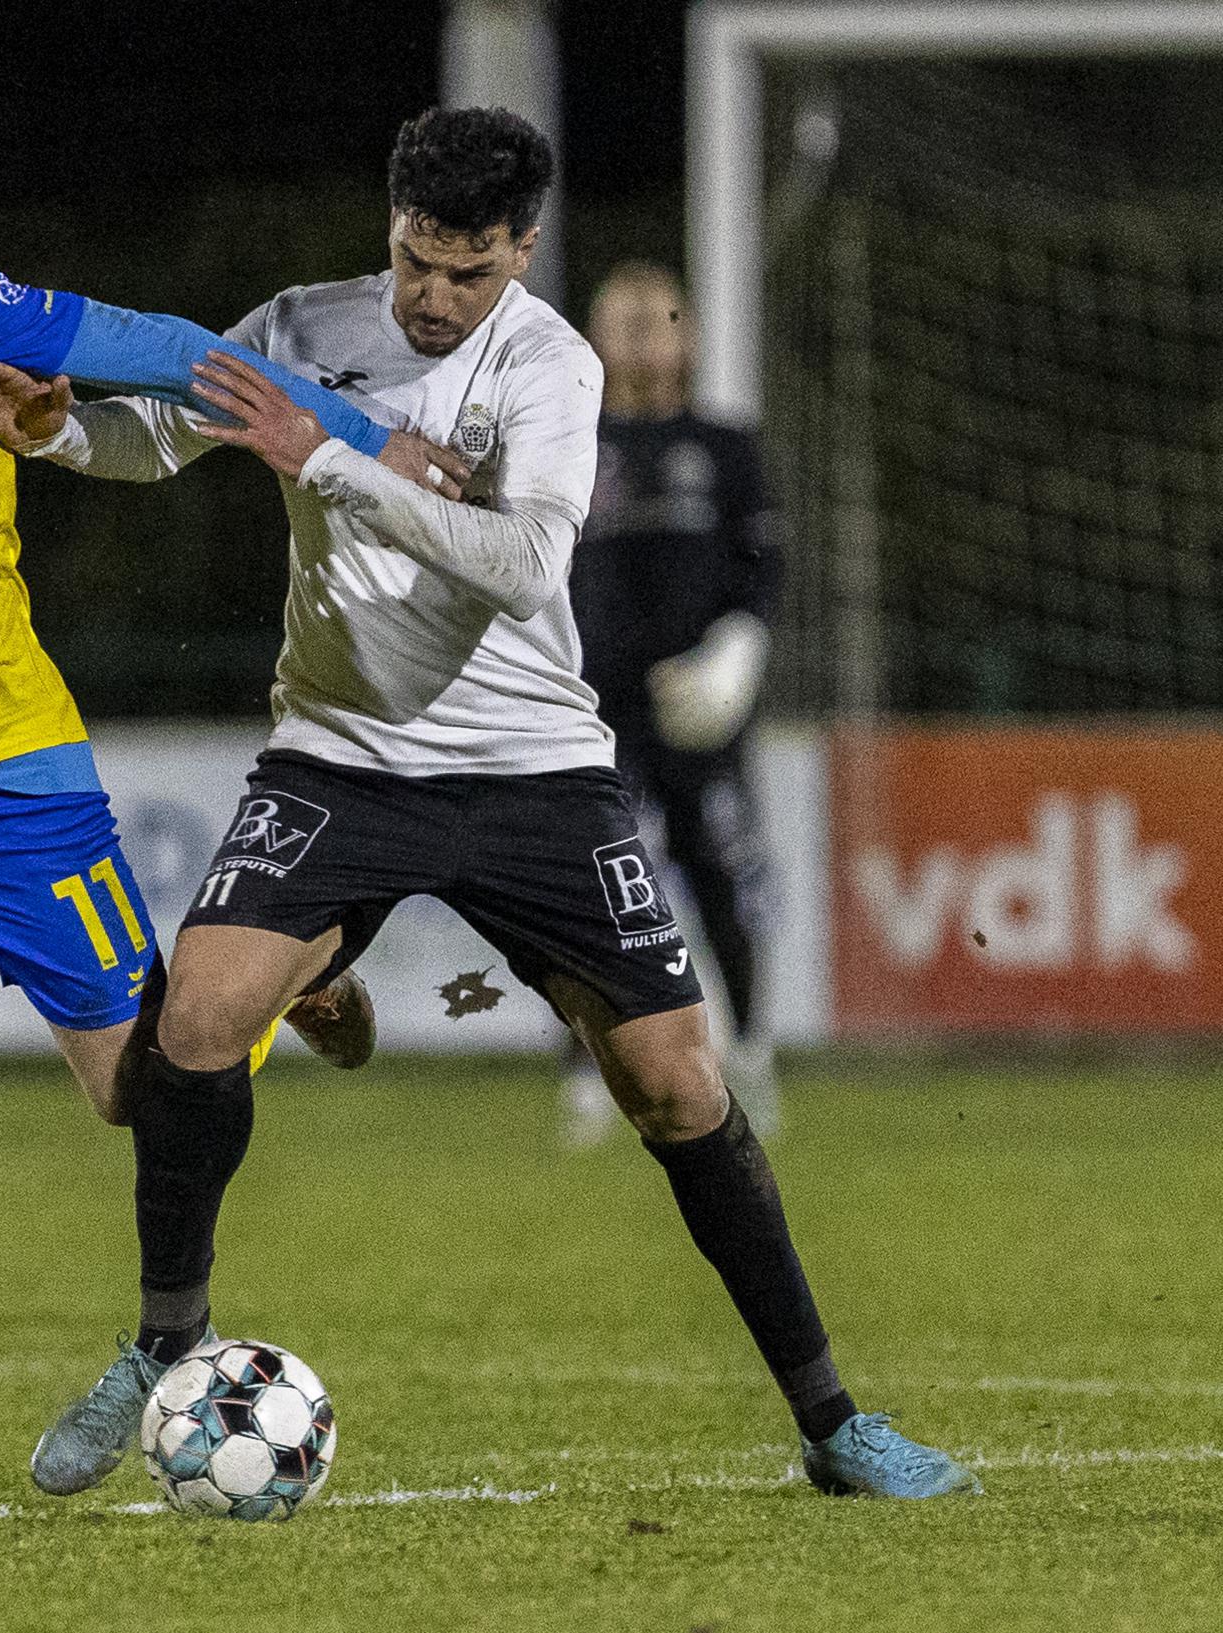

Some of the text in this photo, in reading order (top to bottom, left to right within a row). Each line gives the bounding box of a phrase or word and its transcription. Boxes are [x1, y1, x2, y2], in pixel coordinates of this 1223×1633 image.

[50, 856, 148, 972] 11
[198, 869, 240, 908] 11
[853, 790, 1199, 972] vdk
